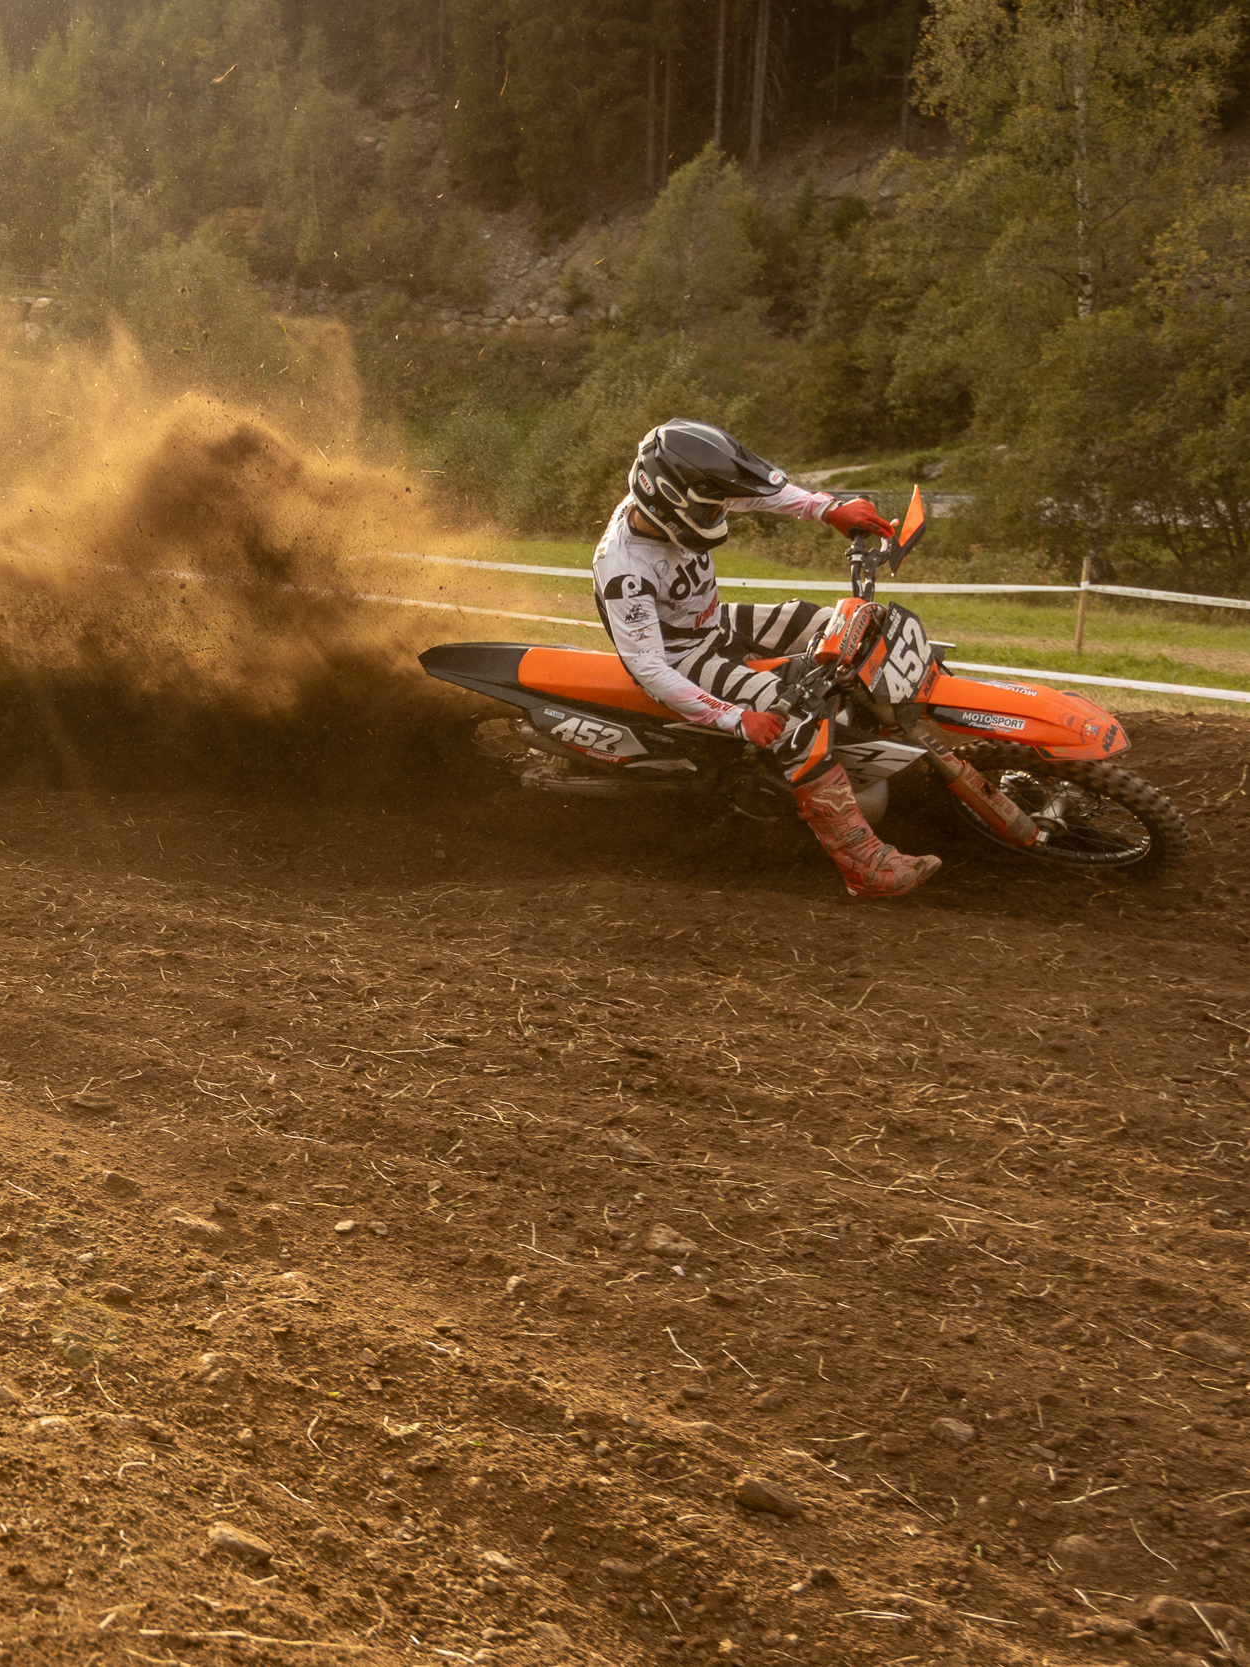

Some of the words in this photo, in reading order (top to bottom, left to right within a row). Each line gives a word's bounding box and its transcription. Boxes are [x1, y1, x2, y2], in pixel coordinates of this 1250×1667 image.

[639, 473, 653, 495] BELL
[846, 607, 872, 658] RENTHAL
[886, 612, 902, 641] GRUBER
[883, 617, 932, 704] 452
[550, 716, 624, 754] 452
[1102, 723, 1119, 753] KTM
